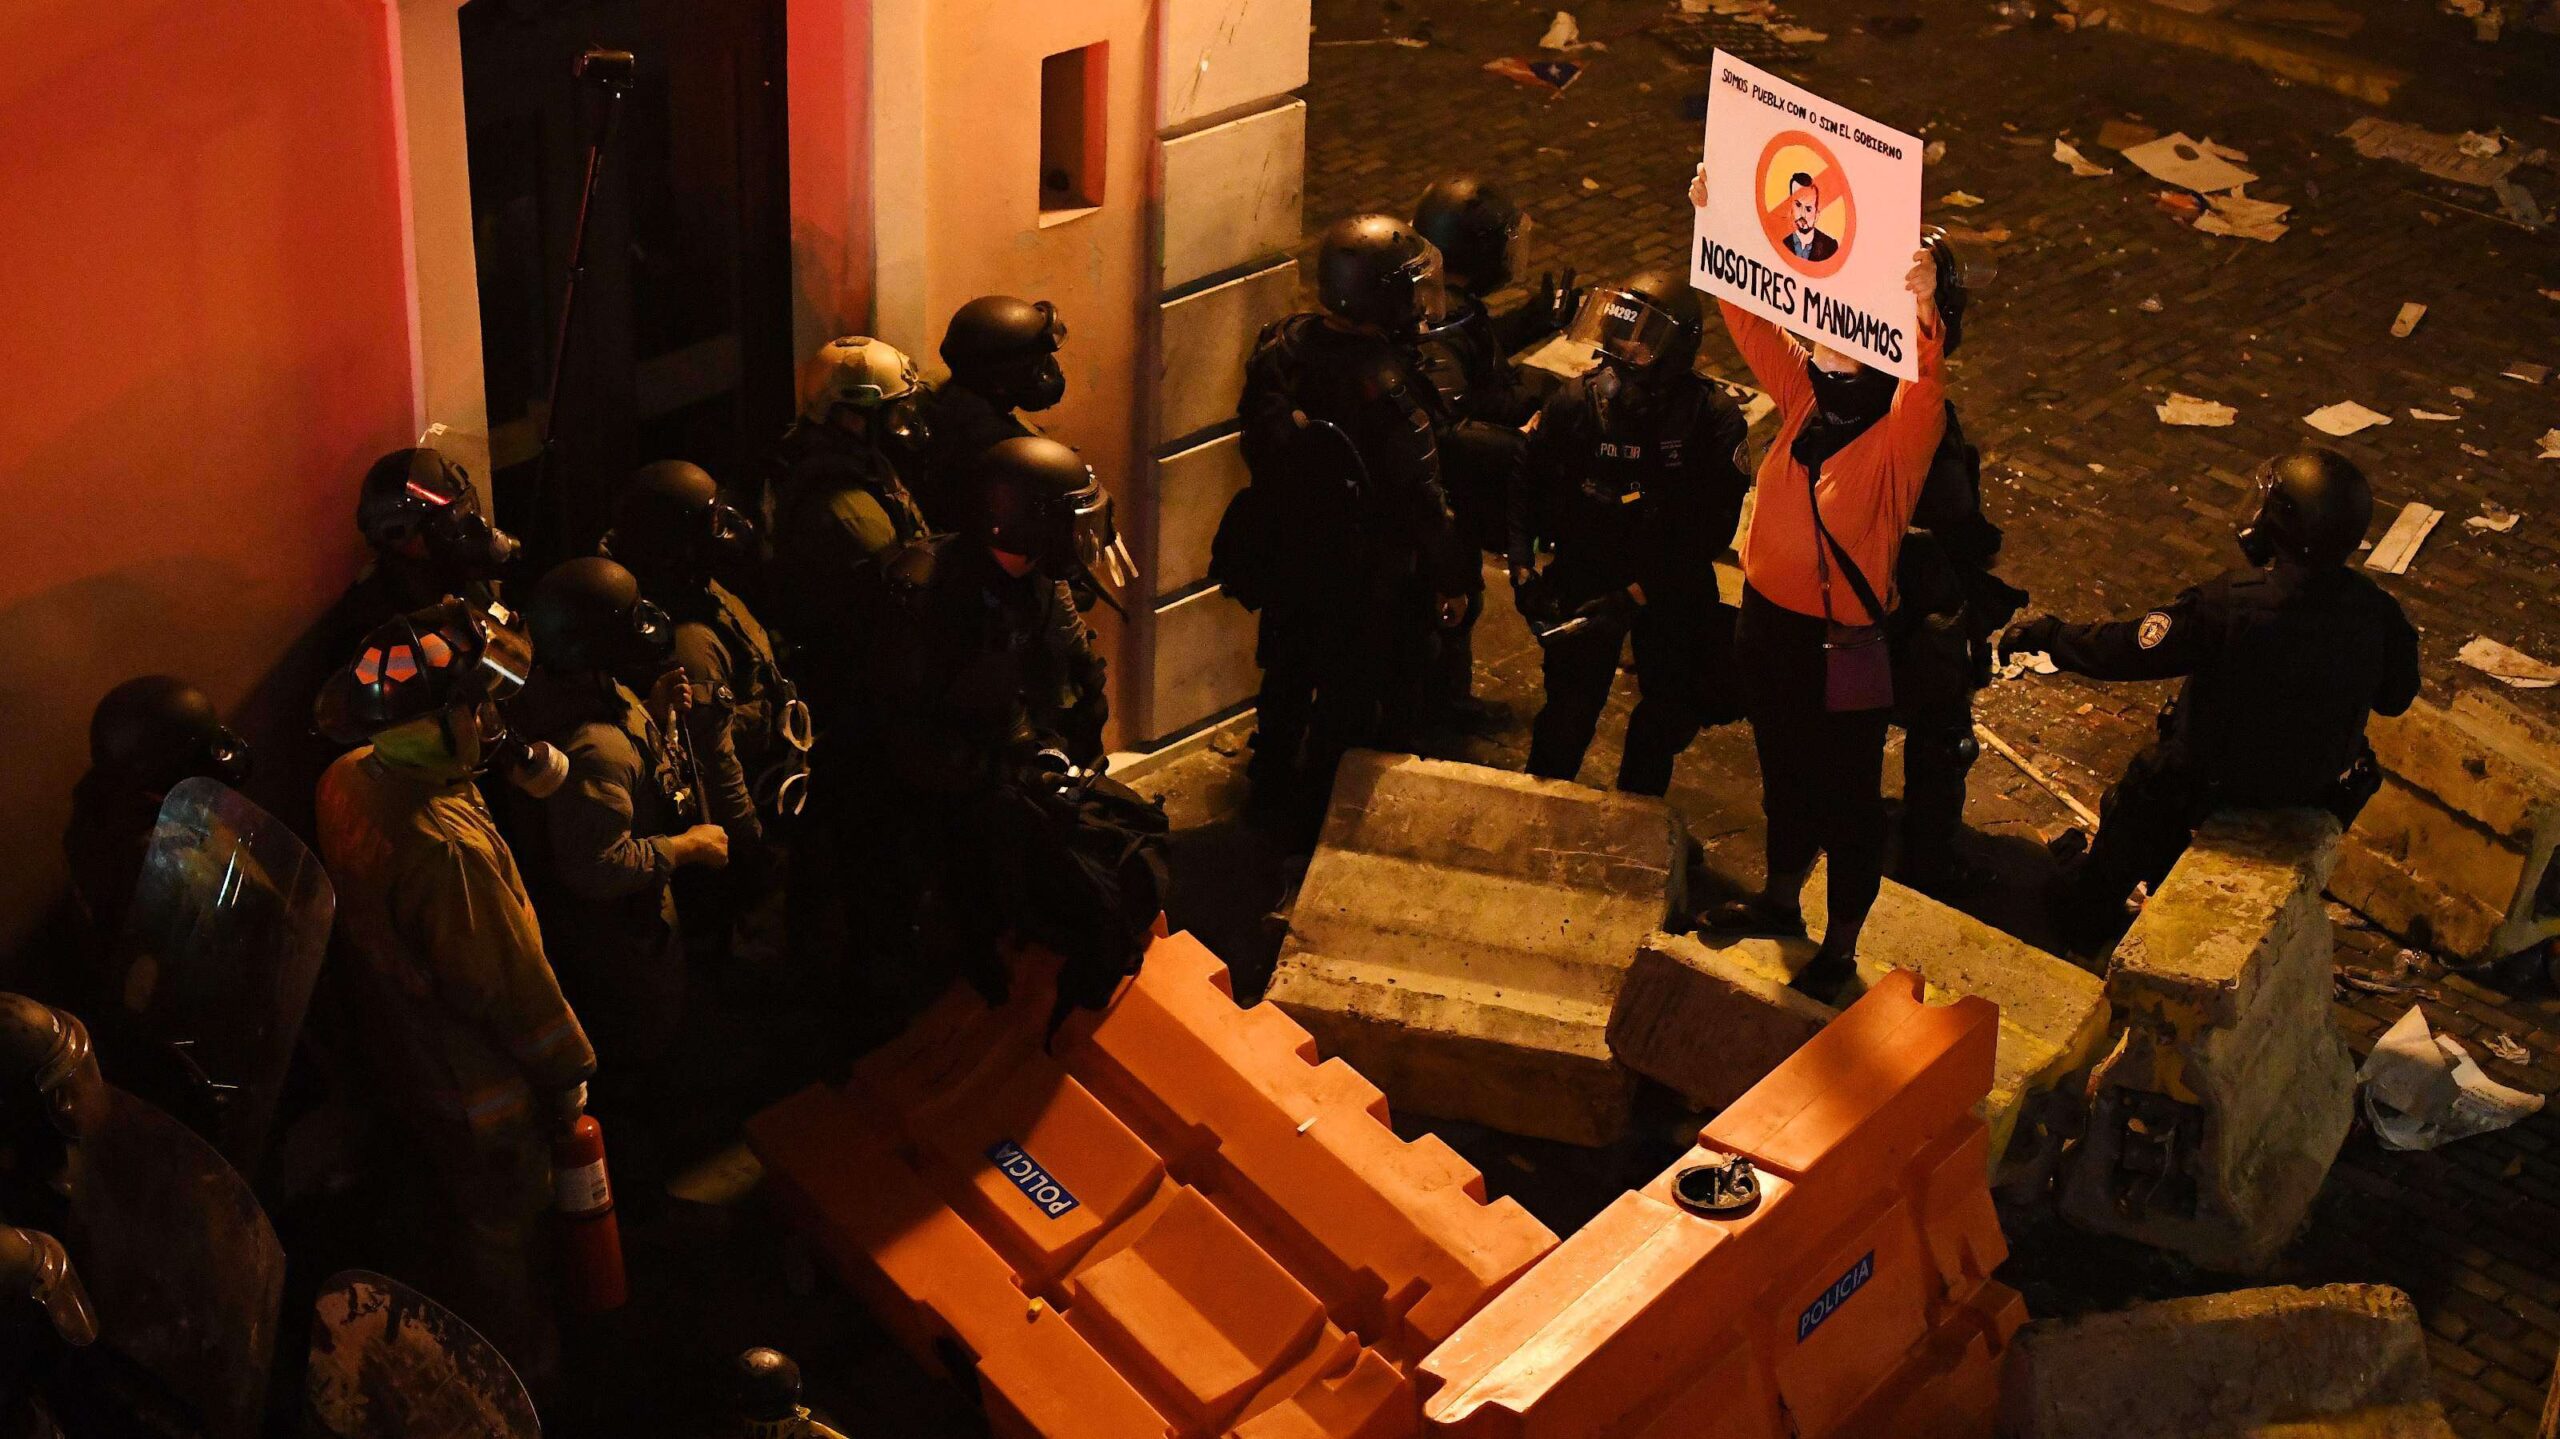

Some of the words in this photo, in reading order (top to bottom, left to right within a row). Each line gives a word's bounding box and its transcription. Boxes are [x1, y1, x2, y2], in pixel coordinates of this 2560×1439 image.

[1722, 68, 1748, 93] SOMOS
[1752, 84, 1785, 111] PUEBLX
[1787, 101, 1807, 119] CON
[1808, 111, 1817, 124] O
[1819, 116, 1838, 134] SIN
[1839, 123, 1851, 139] EL
[1853, 128, 1902, 160] GOBIERNO
[1700, 236, 1796, 315] NOSOTRES
[1802, 286, 1903, 363] MANDAMOS
[996, 1144, 1072, 1214] POLICIA
[1801, 1259, 1869, 1336] POLICIA
